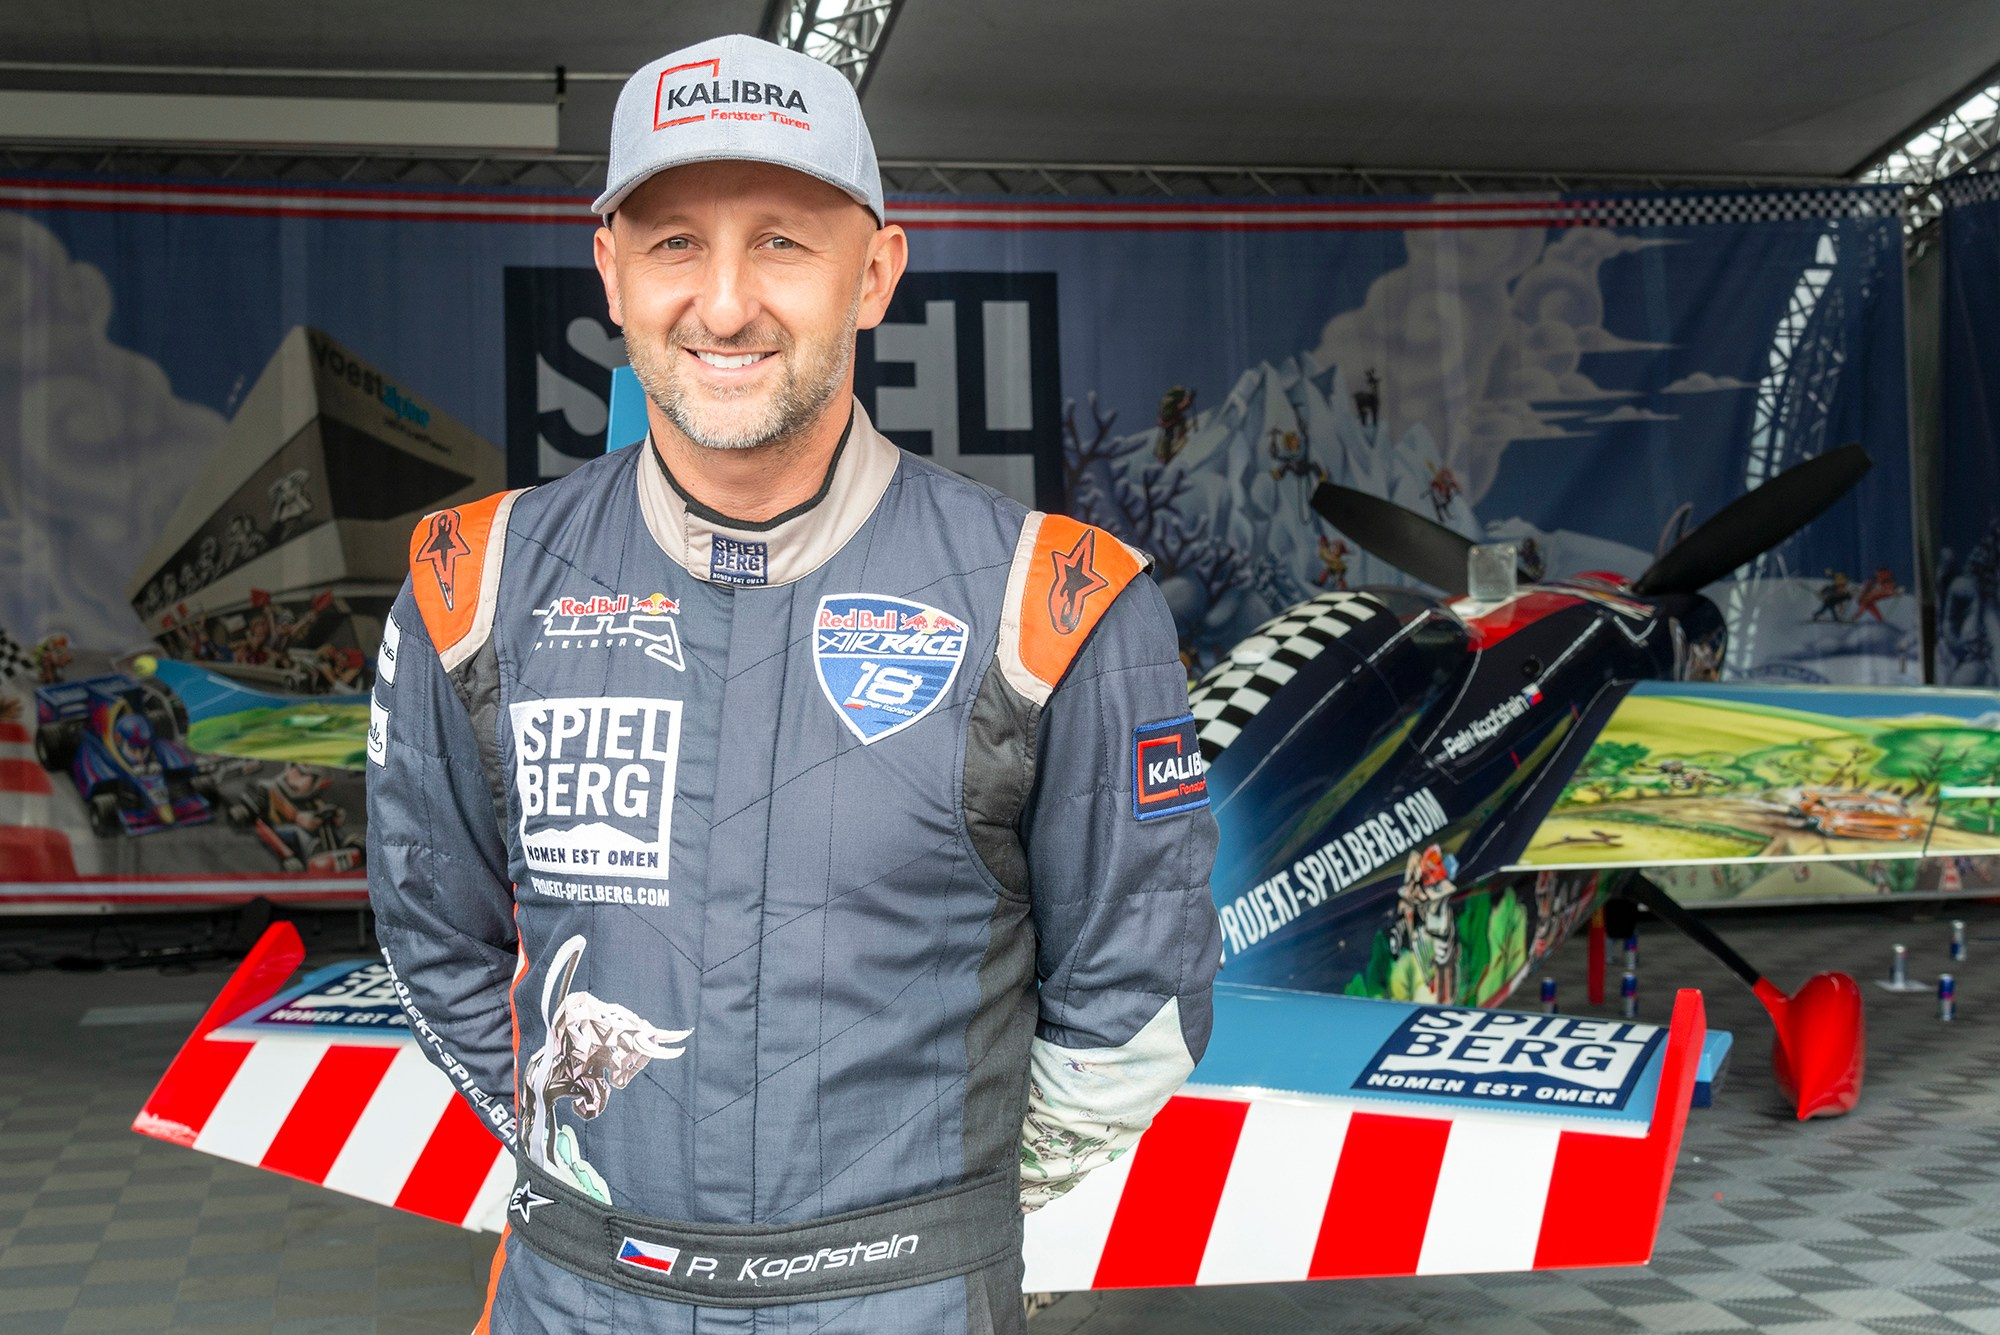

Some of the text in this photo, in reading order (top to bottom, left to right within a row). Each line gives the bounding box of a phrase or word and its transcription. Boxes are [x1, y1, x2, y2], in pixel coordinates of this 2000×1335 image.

[667, 79, 809, 114] KALIBRA
[710, 108, 811, 131] Fenster Türen
[536, 292, 1034, 464] SEL
[715, 538, 764, 556] SPIEL
[715, 551, 760, 570] BERG
[560, 595, 629, 616] Red Bull
[818, 609, 897, 631] Red Bull
[819, 631, 964, 656] AIR RACE
[850, 660, 924, 706] 18
[523, 706, 667, 762] SPIEL
[523, 762, 651, 819] BERG
[526, 845, 659, 868] NOMEN EST OMEN
[530, 876, 670, 907] PROJEKT-SPIELBERG.COM
[269, 1008, 346, 1023] NOMEN
[344, 1011, 390, 1024] EST
[1415, 1009, 1653, 1043] SPIEL
[1406, 1031, 1618, 1072] BERG
[1366, 1073, 1618, 1105] NOMEN EST OMEN
[686, 1233, 920, 1282] P. Kopfstein
